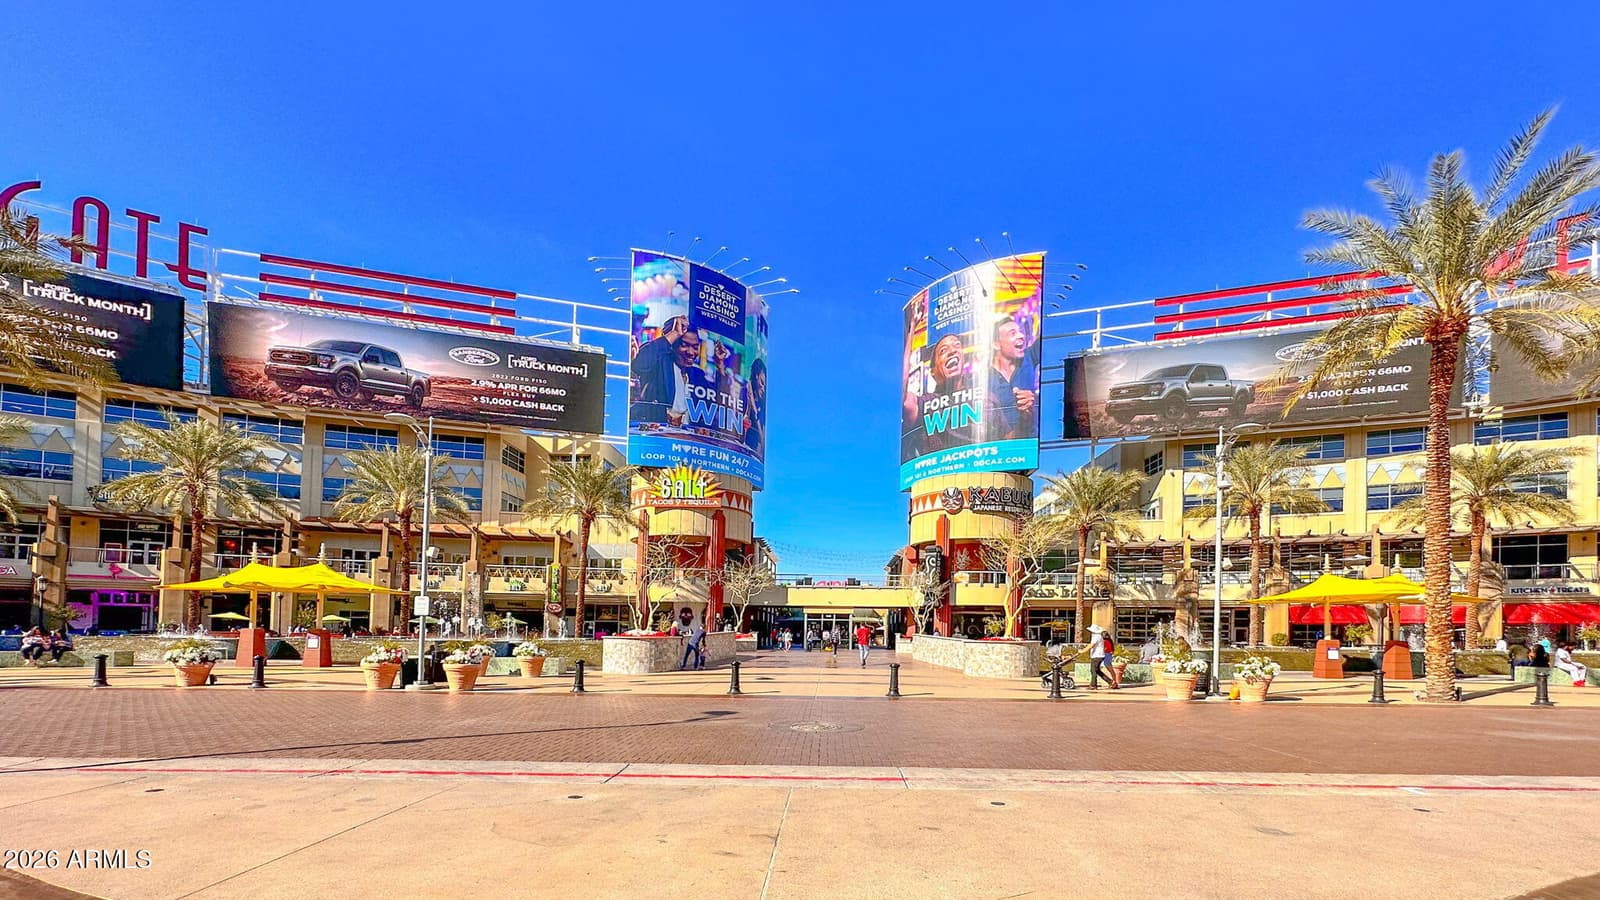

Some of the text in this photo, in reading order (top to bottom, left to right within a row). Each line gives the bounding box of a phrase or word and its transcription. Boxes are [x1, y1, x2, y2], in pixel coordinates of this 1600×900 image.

[699, 291, 739, 313] DIAMOND
[703, 285, 736, 304] DESERT
[938, 289, 970, 306] DESERT
[700, 310, 737, 328] WEST VALLEY
[703, 301, 736, 319] CASINO
[937, 303, 970, 321] CASINO
[76, 326, 119, 340] 66MO
[1377, 365, 1412, 376] 66MO
[471, 379, 567, 397] 2.9% APR FOR 66MO
[1306, 388, 1344, 400] $1,000
[1345, 385, 1376, 396] CASH
[1377, 383, 1409, 394] BACK
[480, 395, 511, 406] $1,000
[512, 399, 539, 410] CASH
[540, 402, 565, 412] BACK
[685, 384, 744, 411] FOR THE
[923, 388, 985, 414] FOR THE
[685, 397, 744, 436] WIN
[923, 401, 984, 437] WIN
[640, 452, 666, 460] LOOP
[690, 457, 730, 471] NORTHERN
[709, 449, 729, 463] FUN
[731, 455, 750, 468] 24/7
[940, 446, 999, 464] JACKPOTS
[928, 463, 965, 476] NORTHERN
